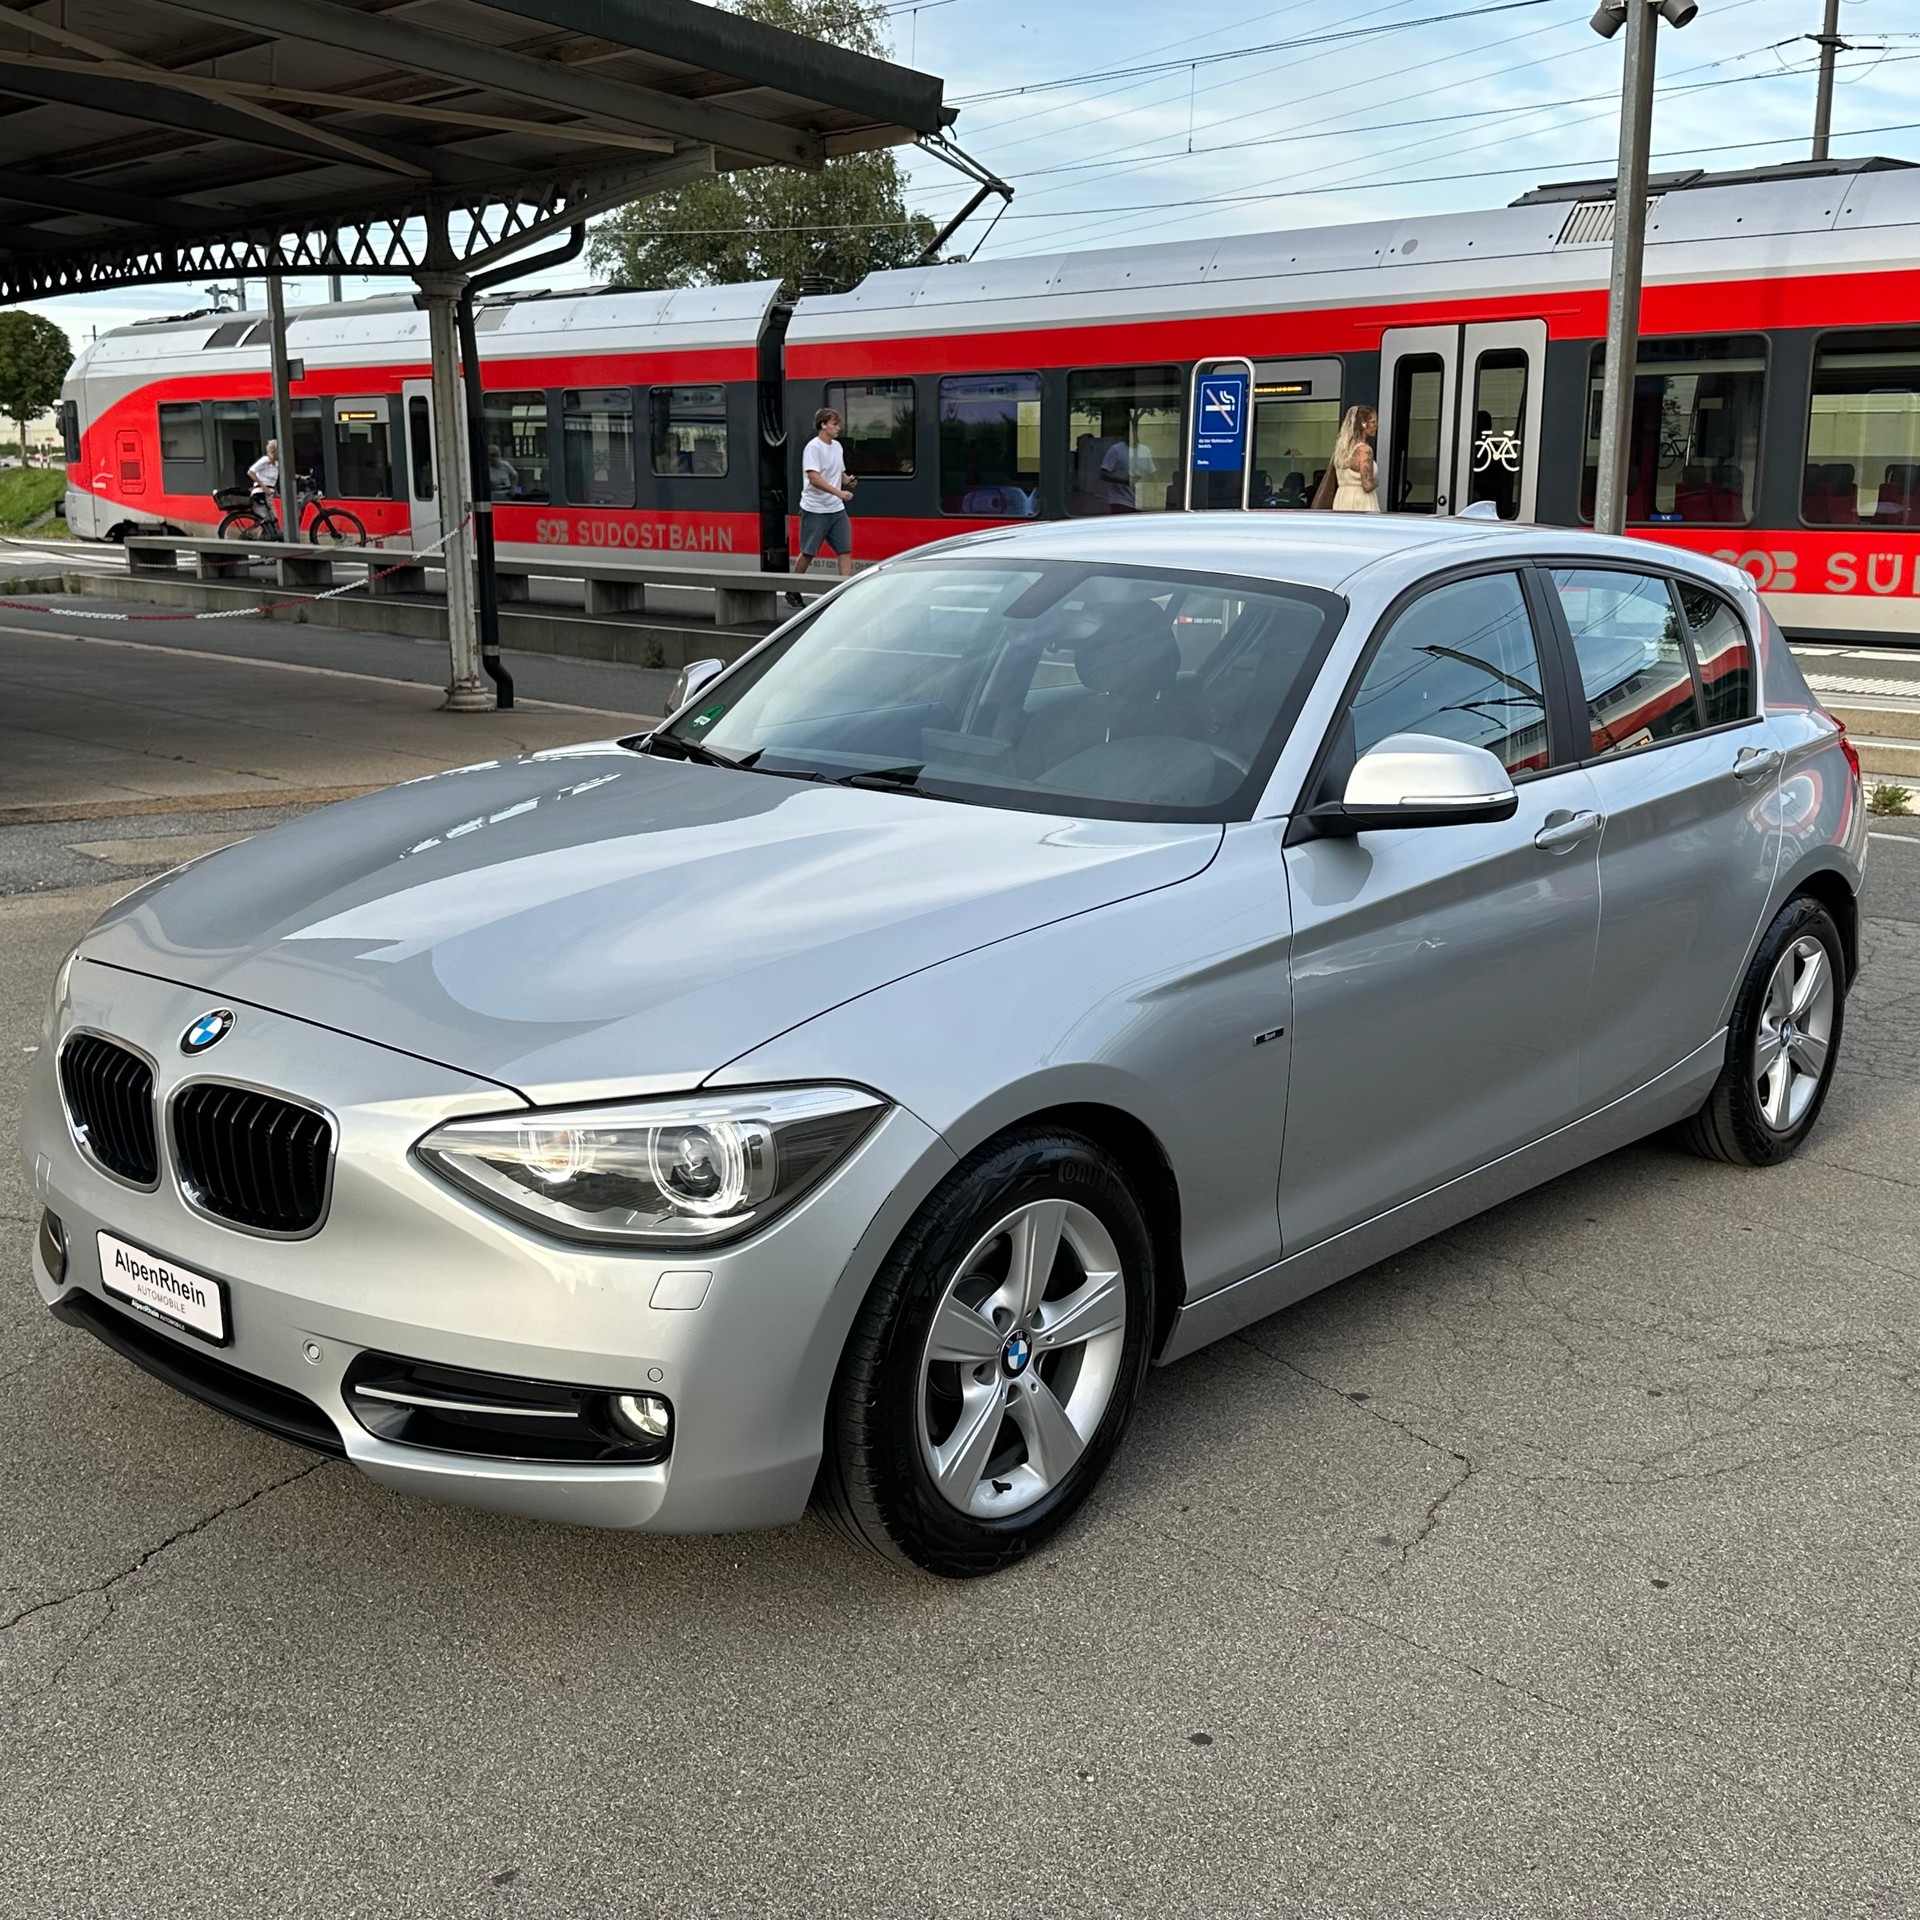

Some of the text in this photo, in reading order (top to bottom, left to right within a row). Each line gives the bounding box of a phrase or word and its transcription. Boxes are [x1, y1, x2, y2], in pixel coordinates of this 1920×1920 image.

[536, 518, 734, 552] SOB SÜDOSTBAHN
[115, 1248, 206, 1308] AlpenRhein
[137, 1284, 187, 1314] AUTOMOBILE
